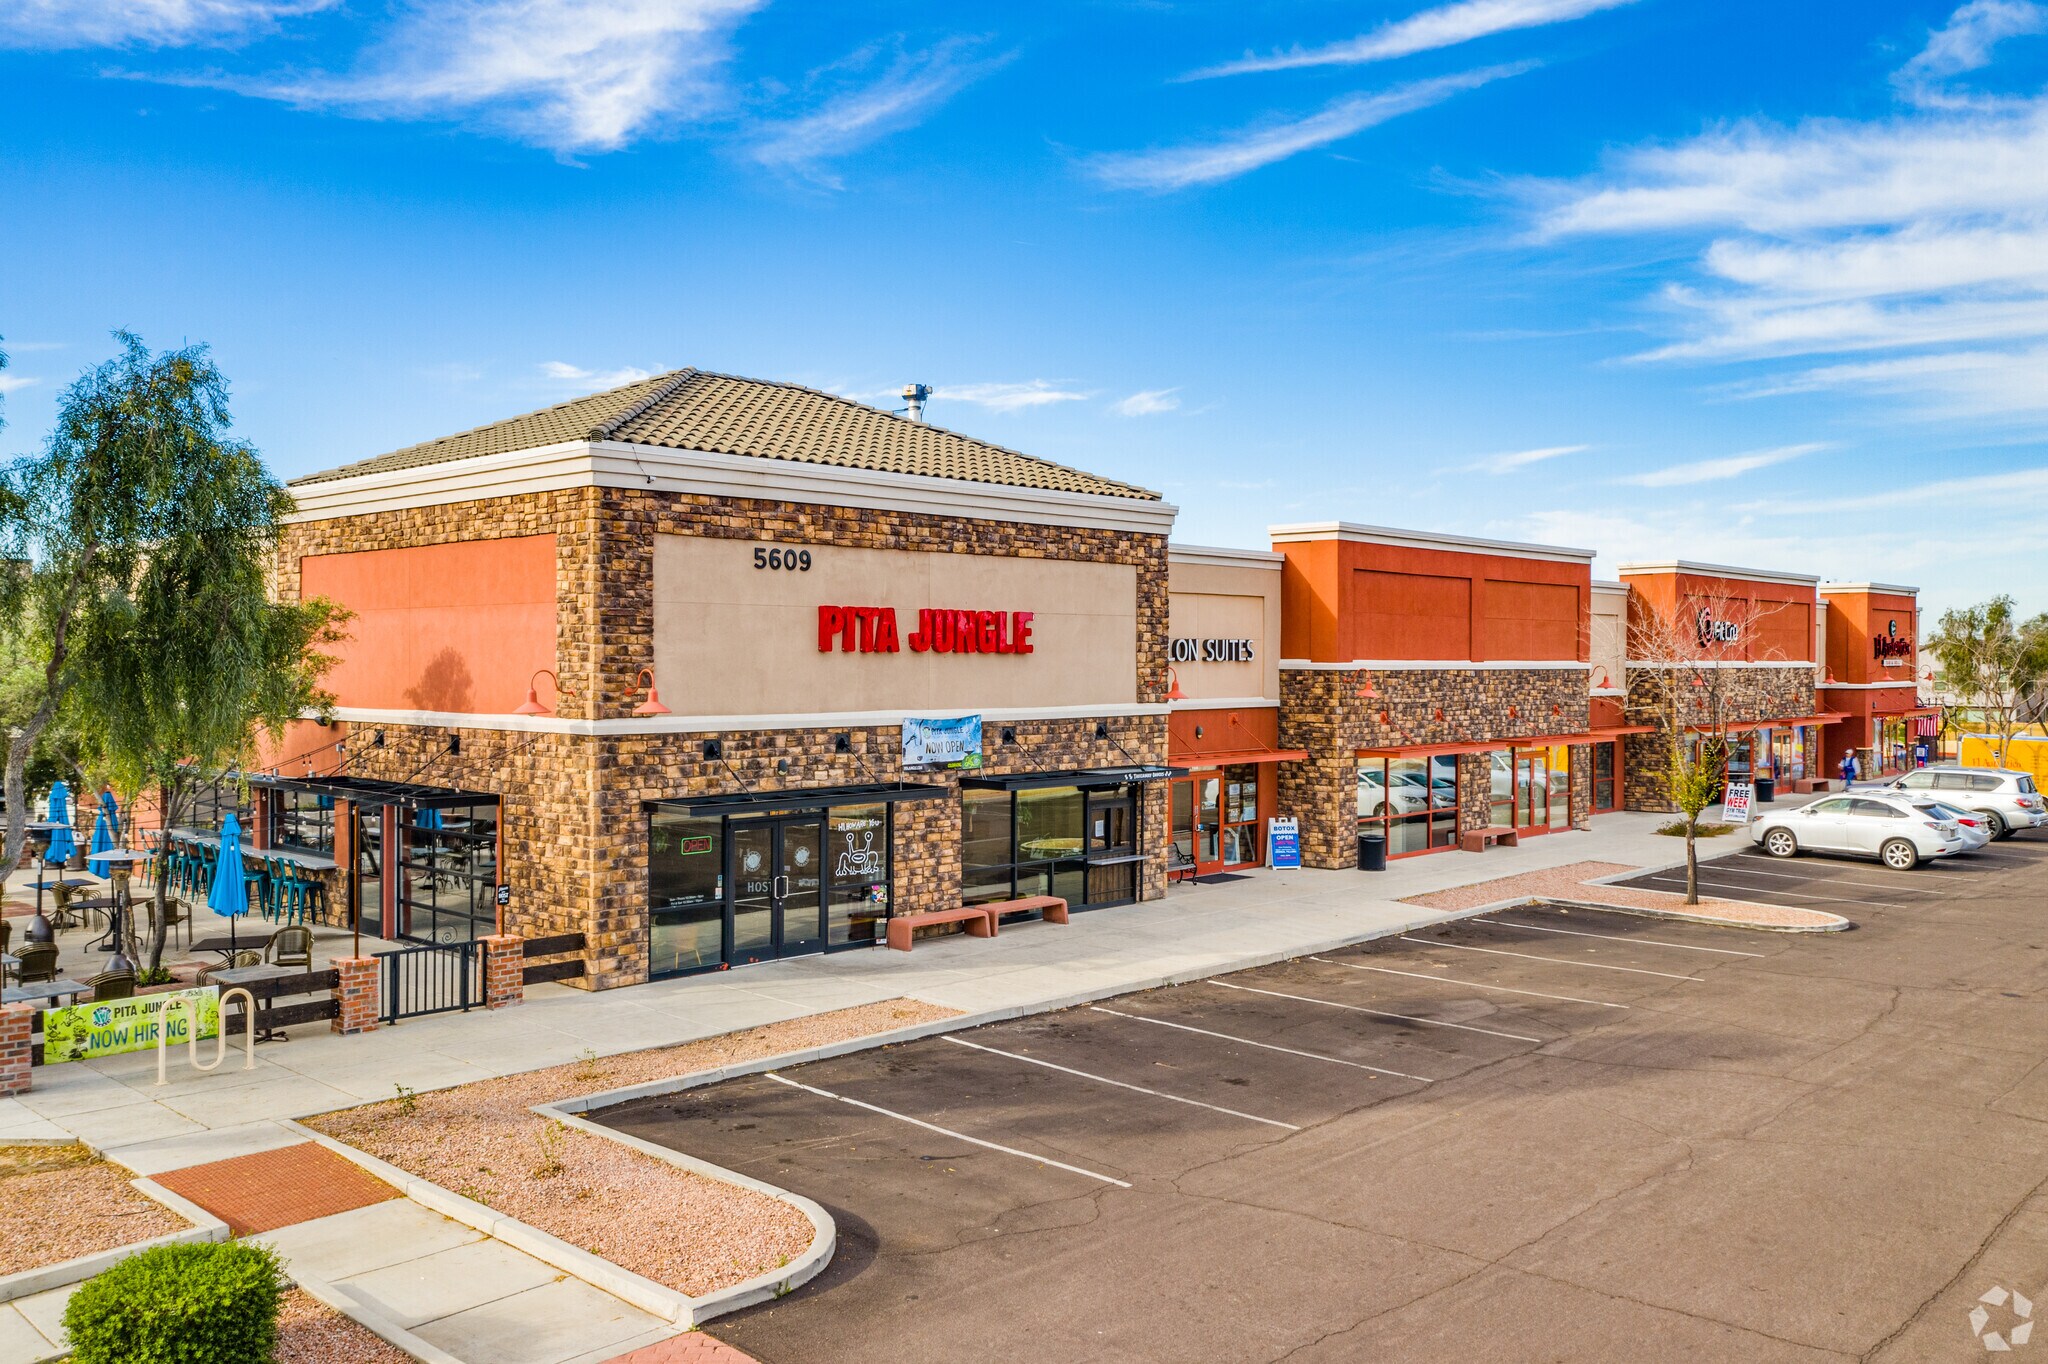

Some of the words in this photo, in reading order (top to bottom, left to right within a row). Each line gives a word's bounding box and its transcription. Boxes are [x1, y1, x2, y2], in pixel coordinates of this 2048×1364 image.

[754, 548, 811, 571] 5609
[818, 605, 899, 652] PITA
[908, 608, 1033, 653] JUNGLE
[1204, 639, 1255, 661] SUITES
[926, 742, 943, 754] NOW
[946, 741, 964, 753] OPEN
[1727, 797, 1748, 808] WEEK
[1729, 789, 1750, 798] FREE
[683, 838, 710, 852] OPEN
[114, 1006, 138, 1019] PITA
[142, 1000, 182, 1014] JUNLE
[89, 1027, 128, 1050] NOW
[134, 1018, 187, 1043] HIRNG
